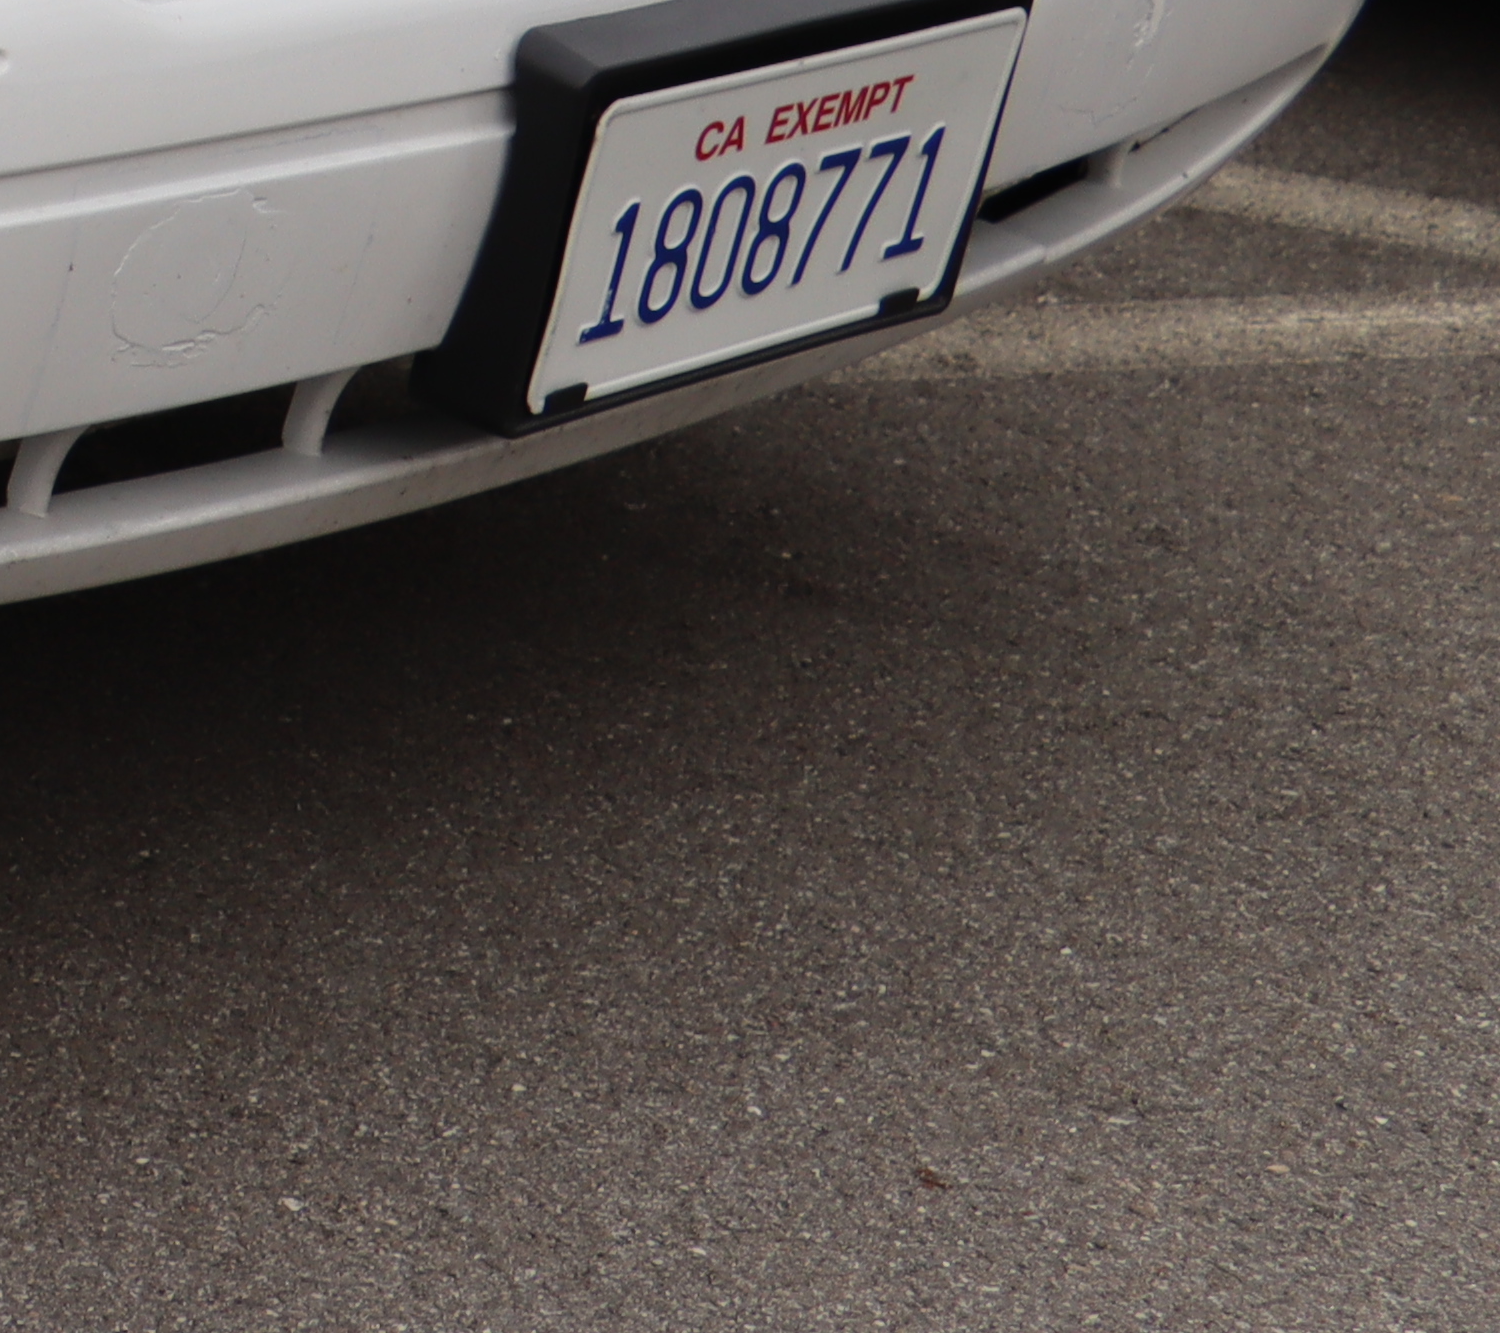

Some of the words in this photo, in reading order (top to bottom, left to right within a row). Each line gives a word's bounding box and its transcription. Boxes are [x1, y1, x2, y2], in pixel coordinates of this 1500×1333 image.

[694, 116, 746, 162] CA
[765, 74, 915, 146] EXEMPT
[578, 123, 947, 344] 1808771
